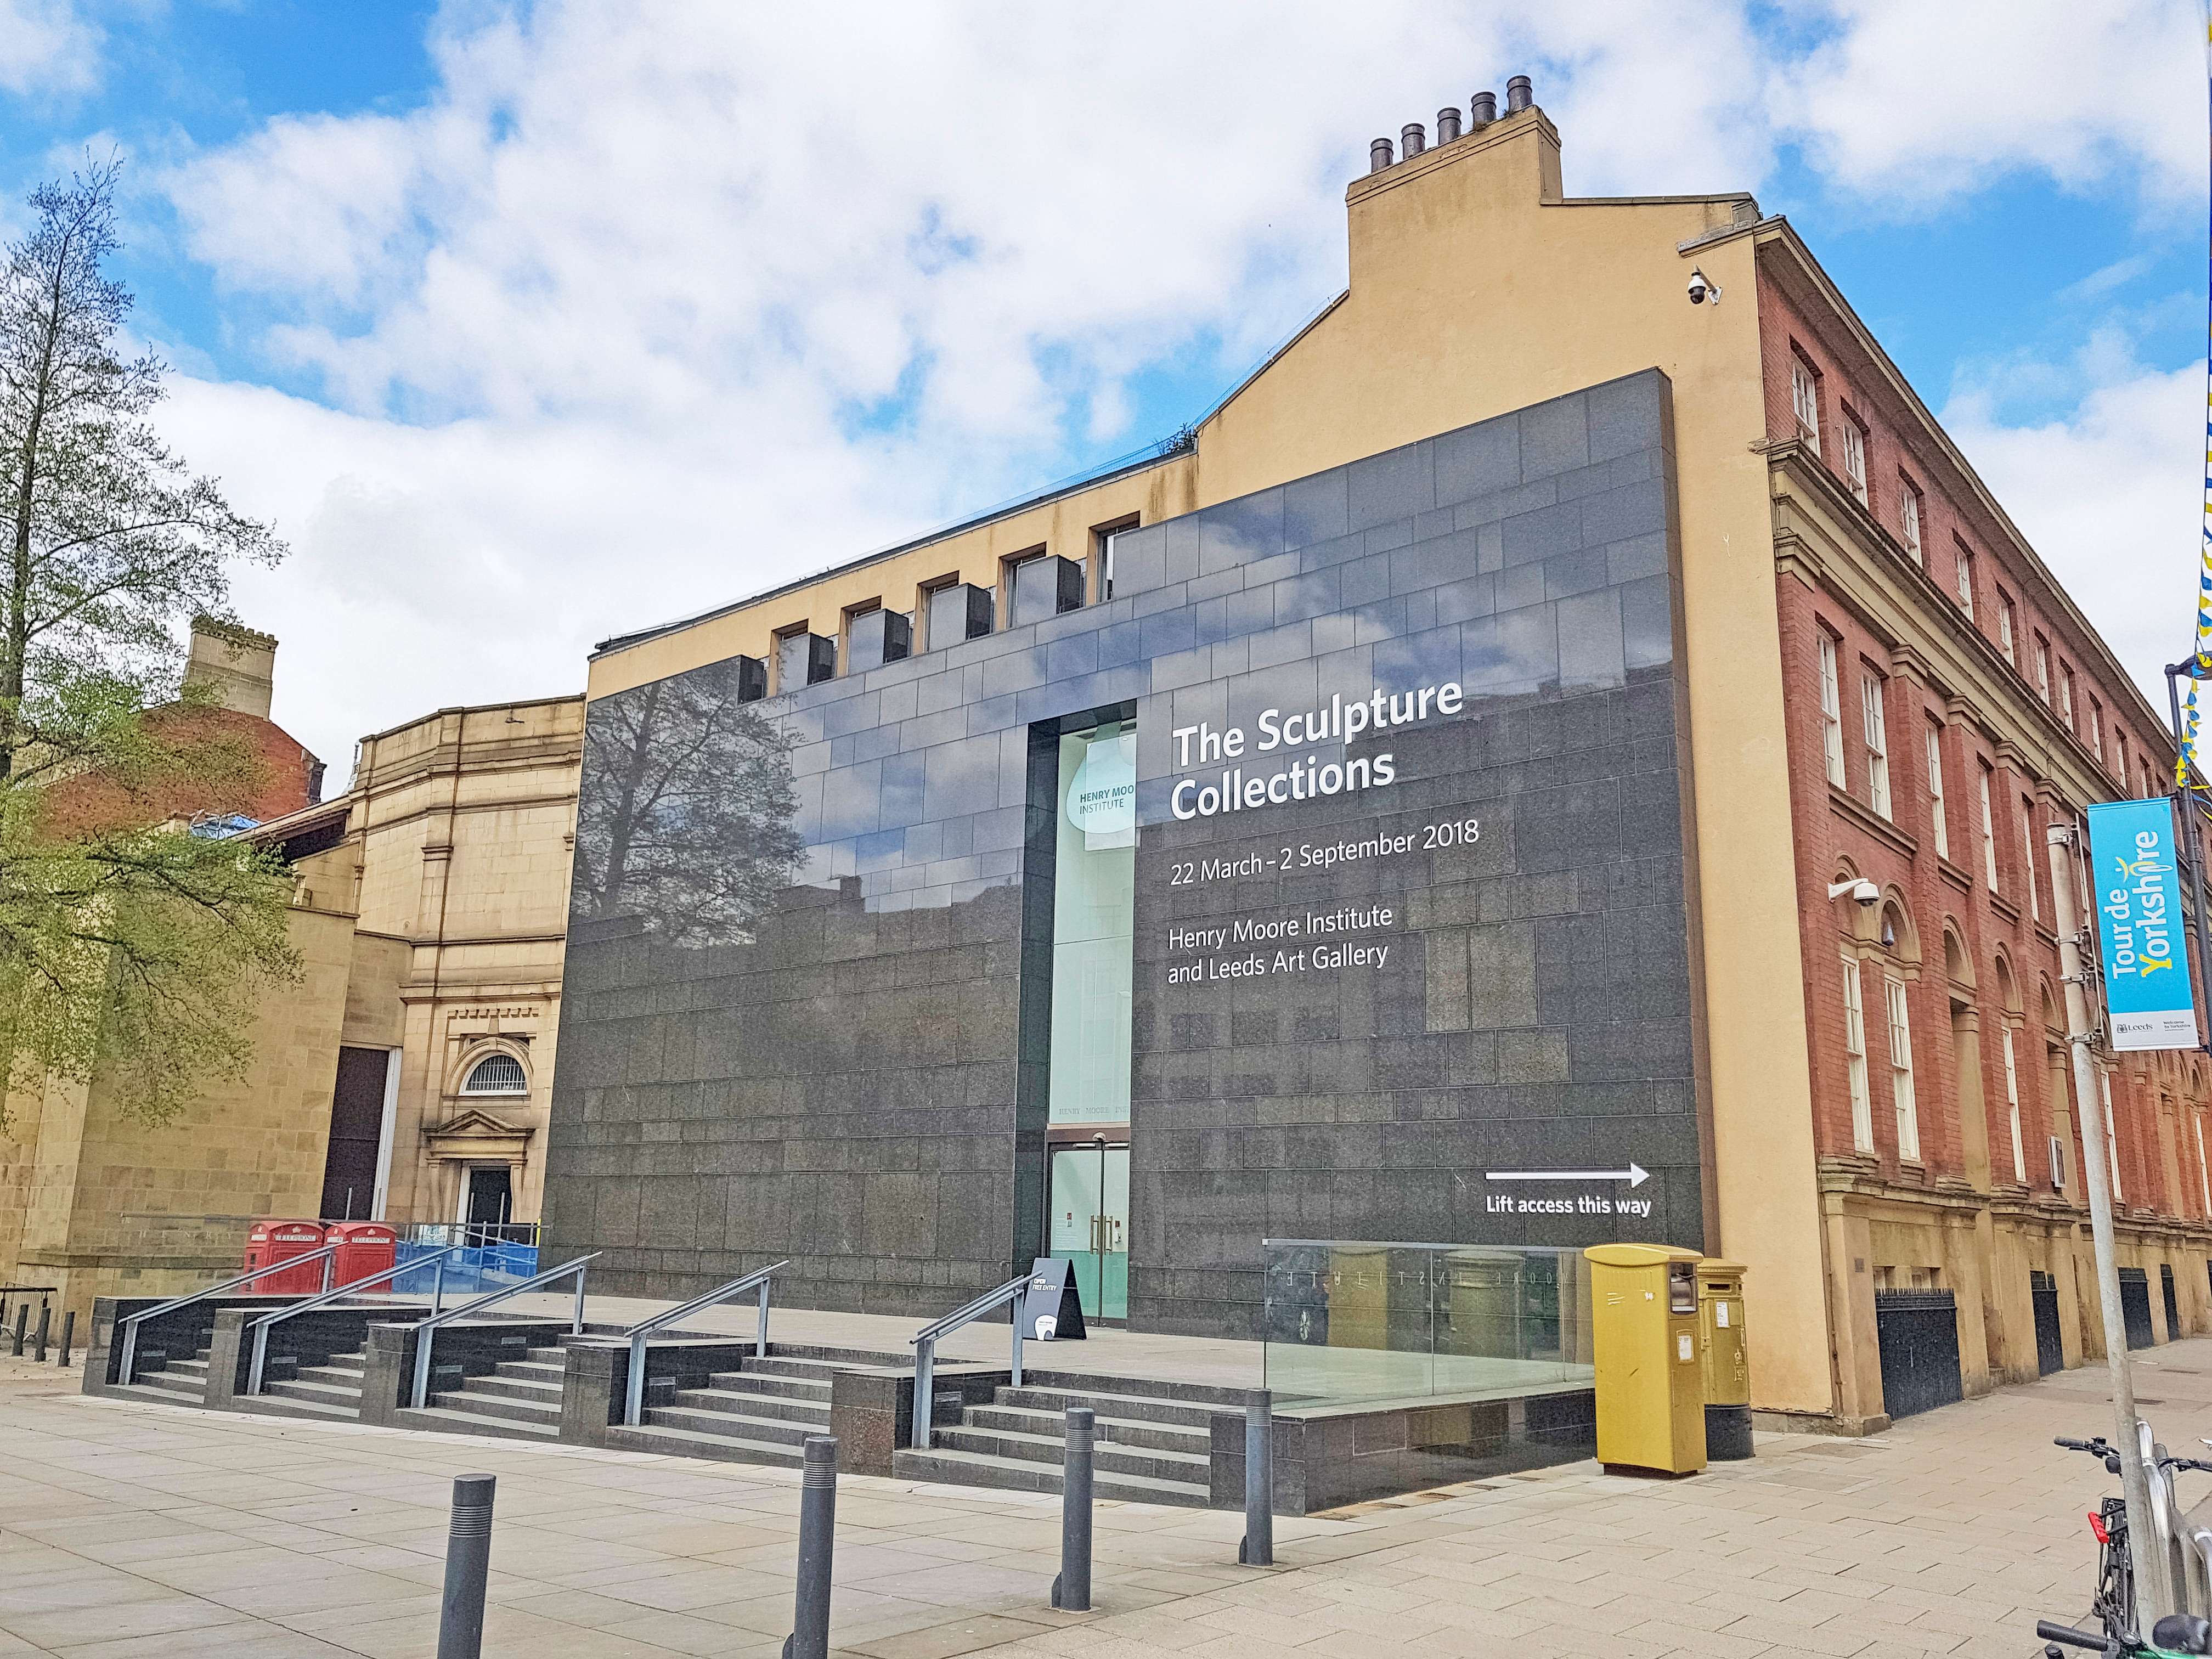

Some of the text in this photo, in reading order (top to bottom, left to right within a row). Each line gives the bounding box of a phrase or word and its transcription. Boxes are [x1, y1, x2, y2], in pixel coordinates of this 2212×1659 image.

[1172, 682, 1463, 766] The Sculpture
[1080, 789, 1110, 803] HENRY
[1080, 798, 1124, 815] INSTITUTE
[1170, 754, 1395, 820] Collections
[1170, 862, 1194, 885] 22
[1299, 832, 1415, 869] September
[1423, 819, 1480, 850] 2018
[1169, 904, 1392, 950] Henry Moore Institute
[2104, 888, 2136, 980] Tour de
[1167, 943, 1389, 984] and Leeds Art Gallery
[1486, 1195, 1652, 1218] Lift access this way
